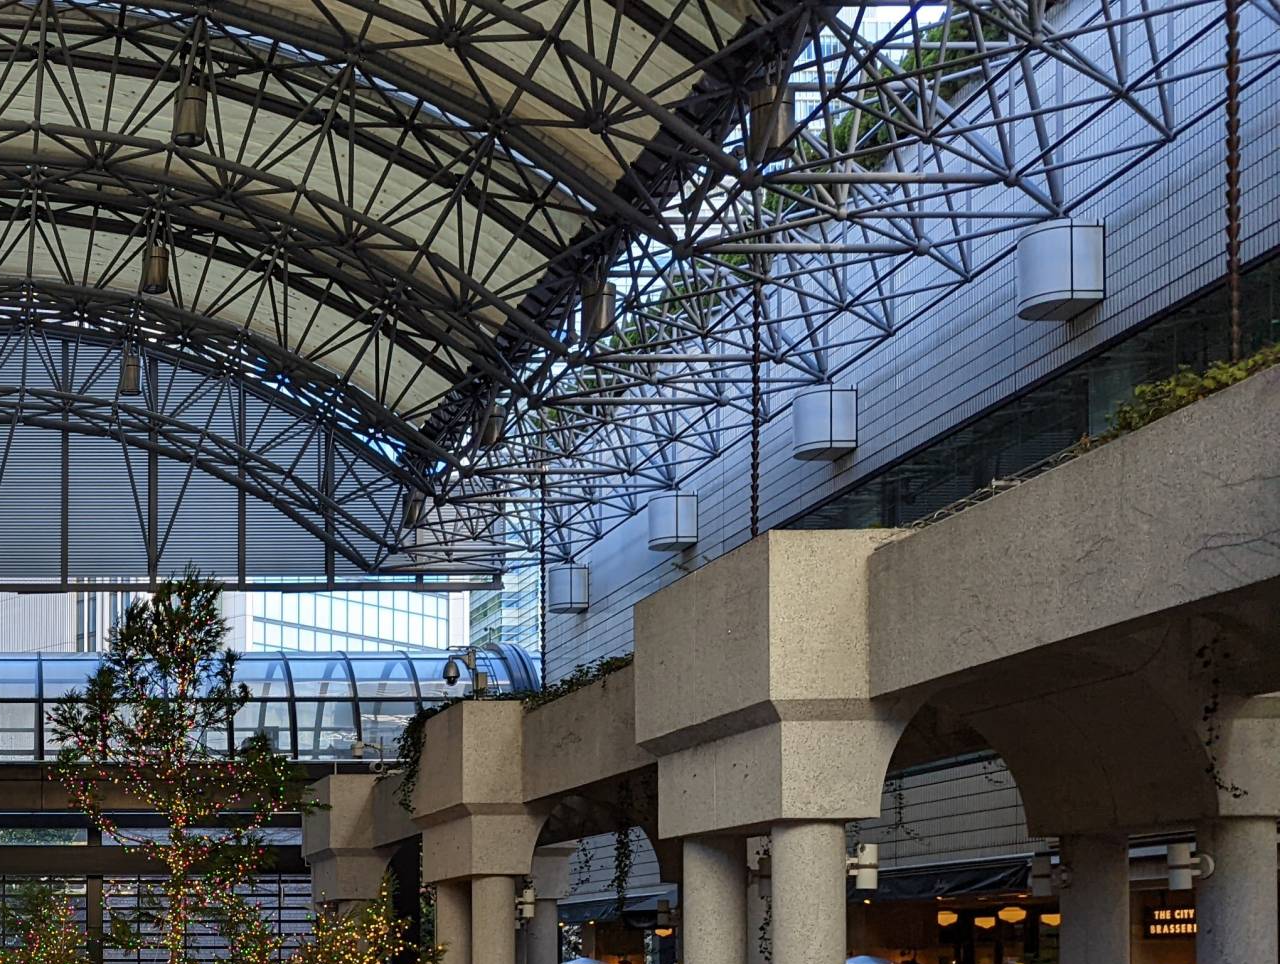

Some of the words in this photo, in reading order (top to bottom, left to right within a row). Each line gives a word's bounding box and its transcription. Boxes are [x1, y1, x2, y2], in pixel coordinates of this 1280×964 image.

[1154, 909, 1171, 920] THE
[1174, 908, 1195, 919] CITY
[1150, 924, 1197, 934] BRASSERI
